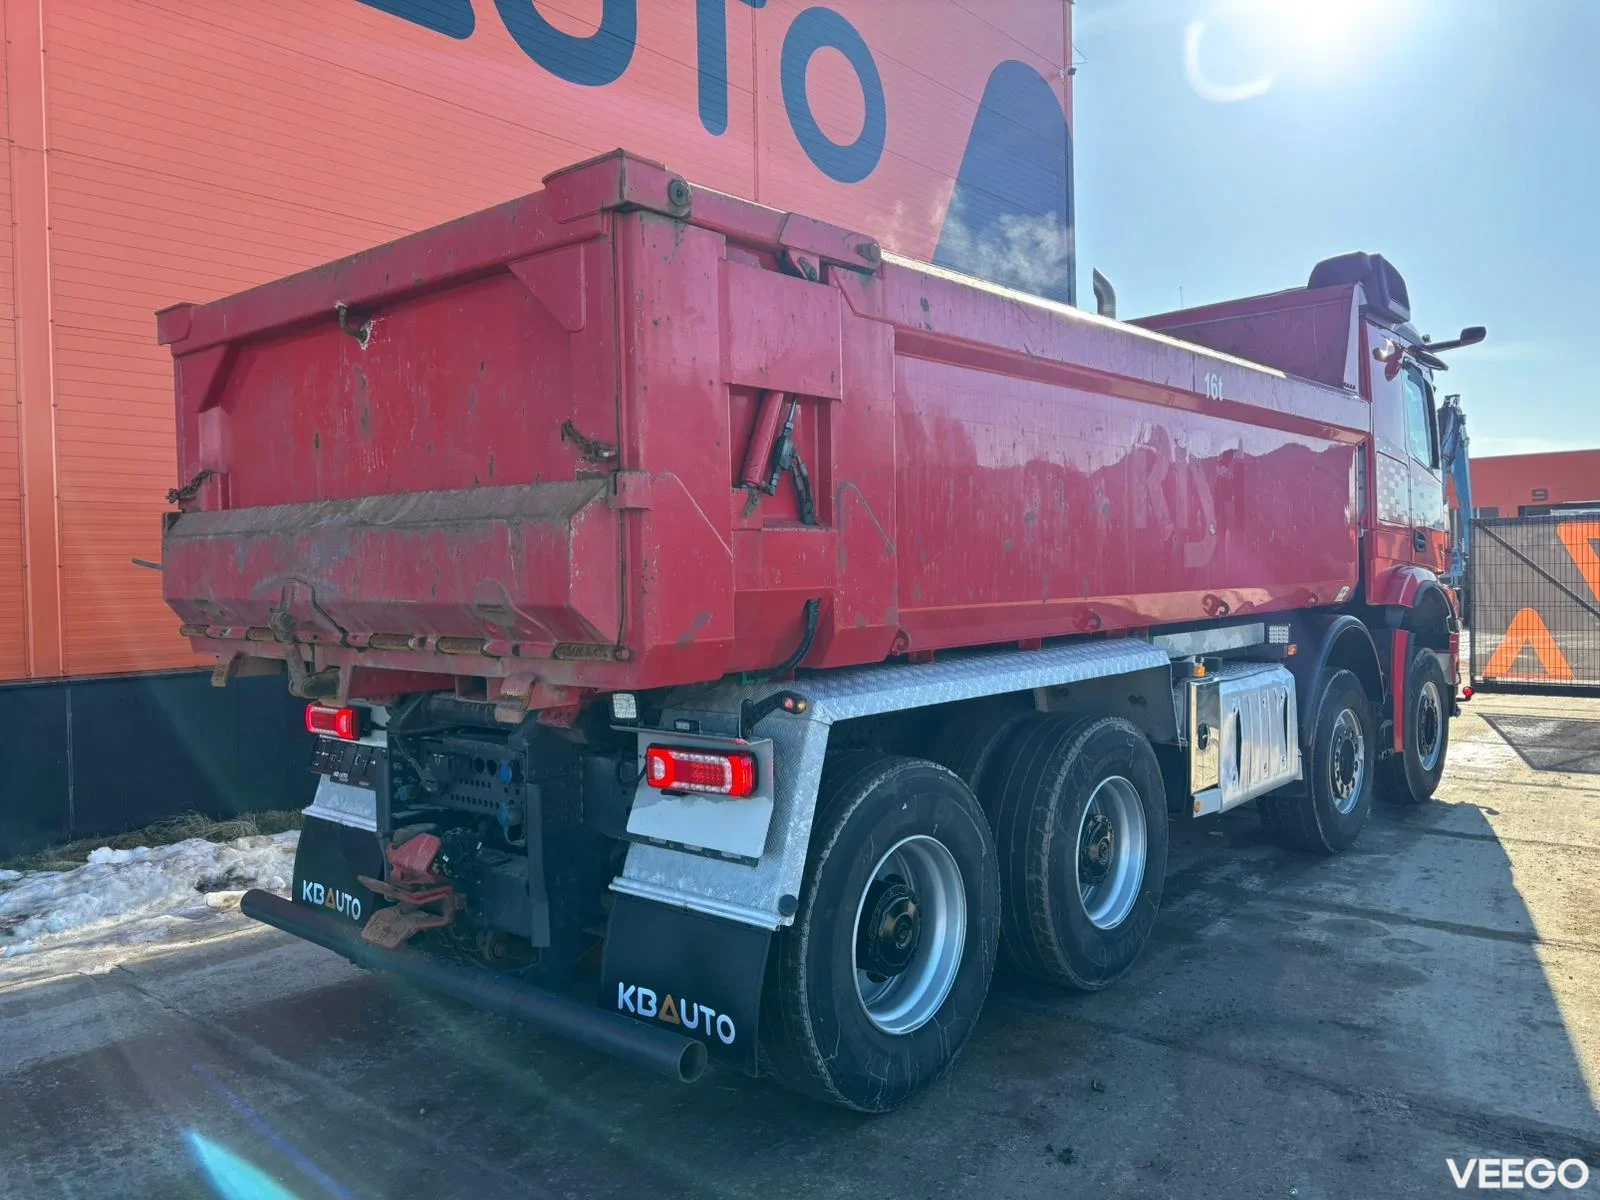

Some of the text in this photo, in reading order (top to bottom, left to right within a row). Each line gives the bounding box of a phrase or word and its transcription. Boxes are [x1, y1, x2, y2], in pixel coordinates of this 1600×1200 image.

[1203, 371, 1223, 402] 16t
[1531, 488, 1549, 502] 9
[302, 879, 362, 921] KBAUTO
[617, 981, 737, 1045] KBAUTO
